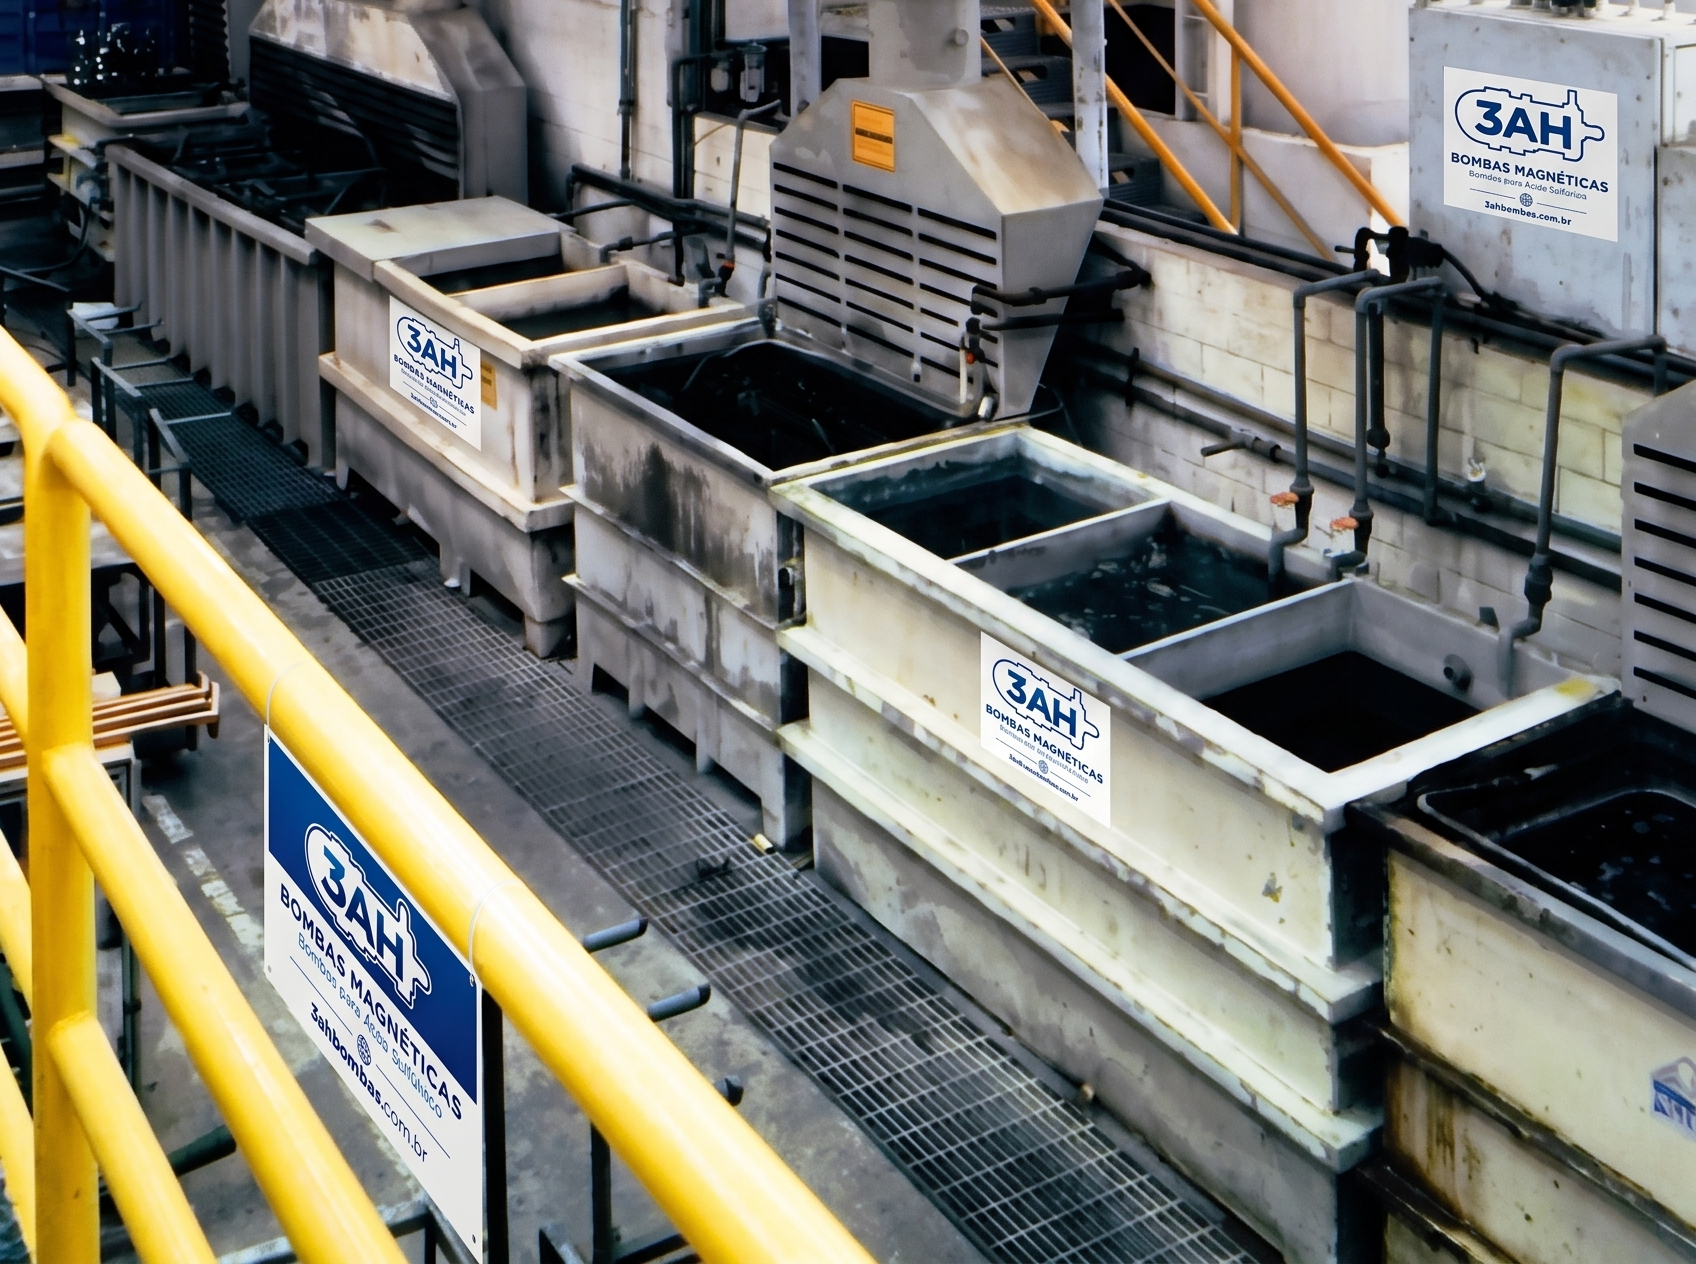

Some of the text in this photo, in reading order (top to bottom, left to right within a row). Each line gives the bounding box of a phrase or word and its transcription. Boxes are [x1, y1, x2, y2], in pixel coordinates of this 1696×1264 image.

[1474, 99, 1572, 151] 3AH
[1451, 152, 1511, 174] BOMBAS
[407, 324, 457, 379] 3AH
[986, 703, 1031, 739] BOMBAS
[1006, 668, 1077, 738] 3AH
[321, 845, 405, 980] 3AH
[280, 883, 463, 1121] BOMBAS MAGNÉTICAS
[311, 1002, 428, 1162] 3ahbombas.com.br
